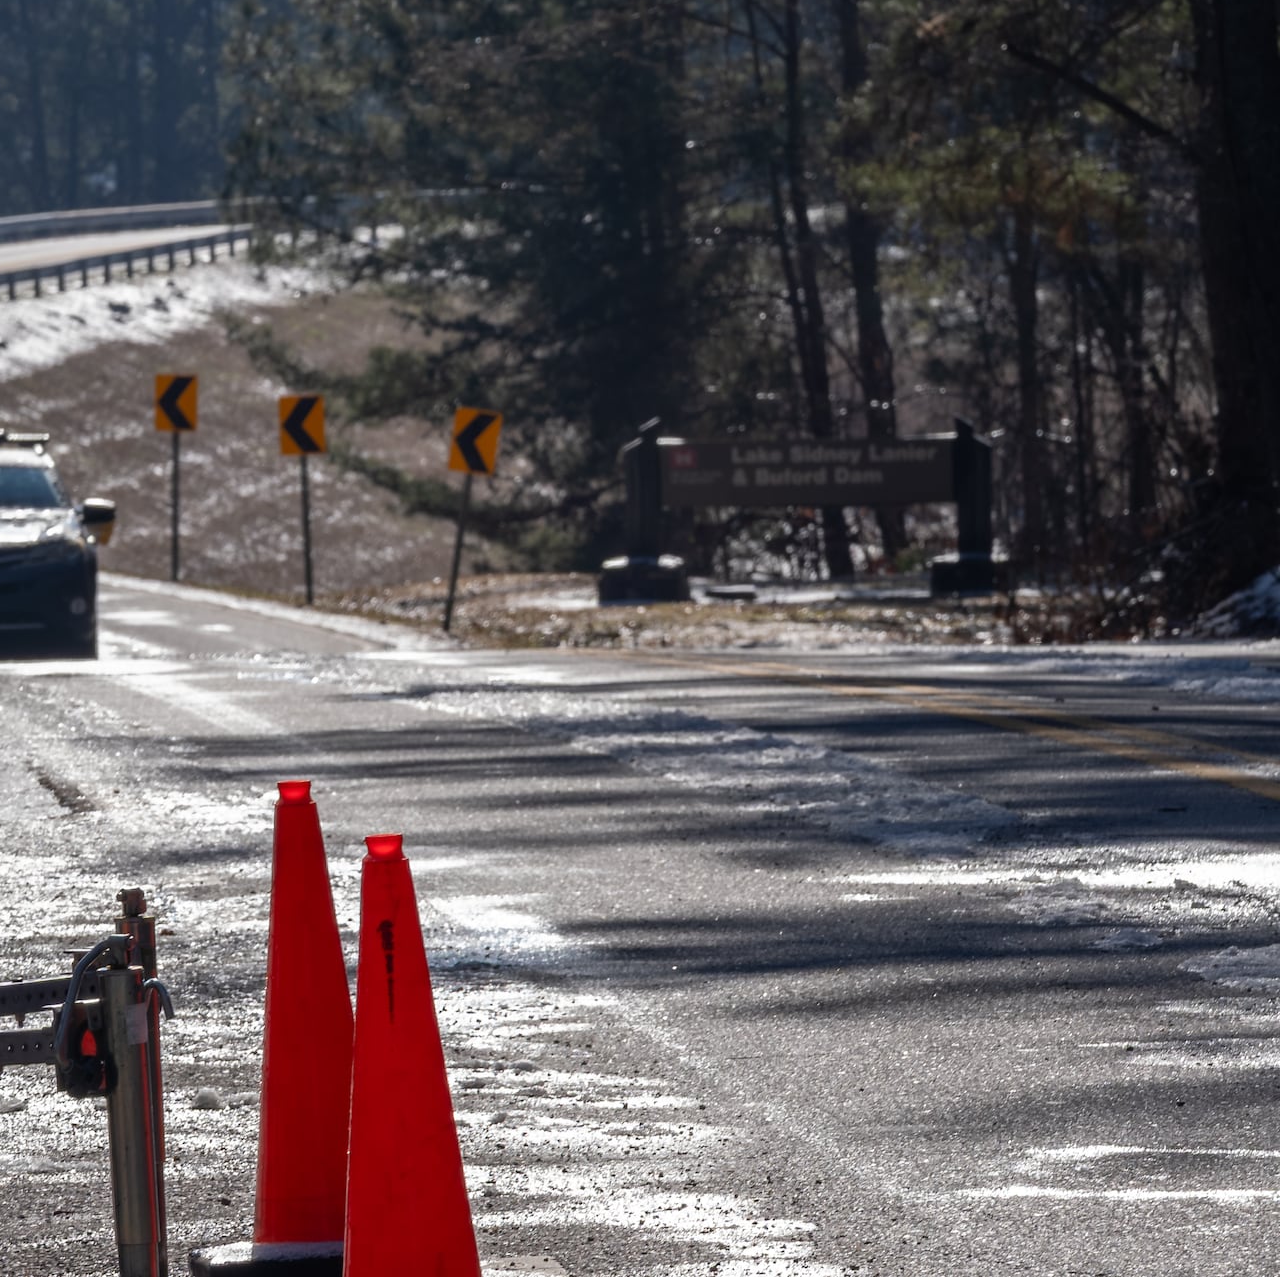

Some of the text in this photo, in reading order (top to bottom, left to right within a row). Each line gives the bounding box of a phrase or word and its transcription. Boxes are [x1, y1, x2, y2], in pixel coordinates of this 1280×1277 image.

[731, 444, 937, 466] Lake Sidney Lanier
[754, 466, 827, 486] Buford
[833, 466, 885, 485] Dam
